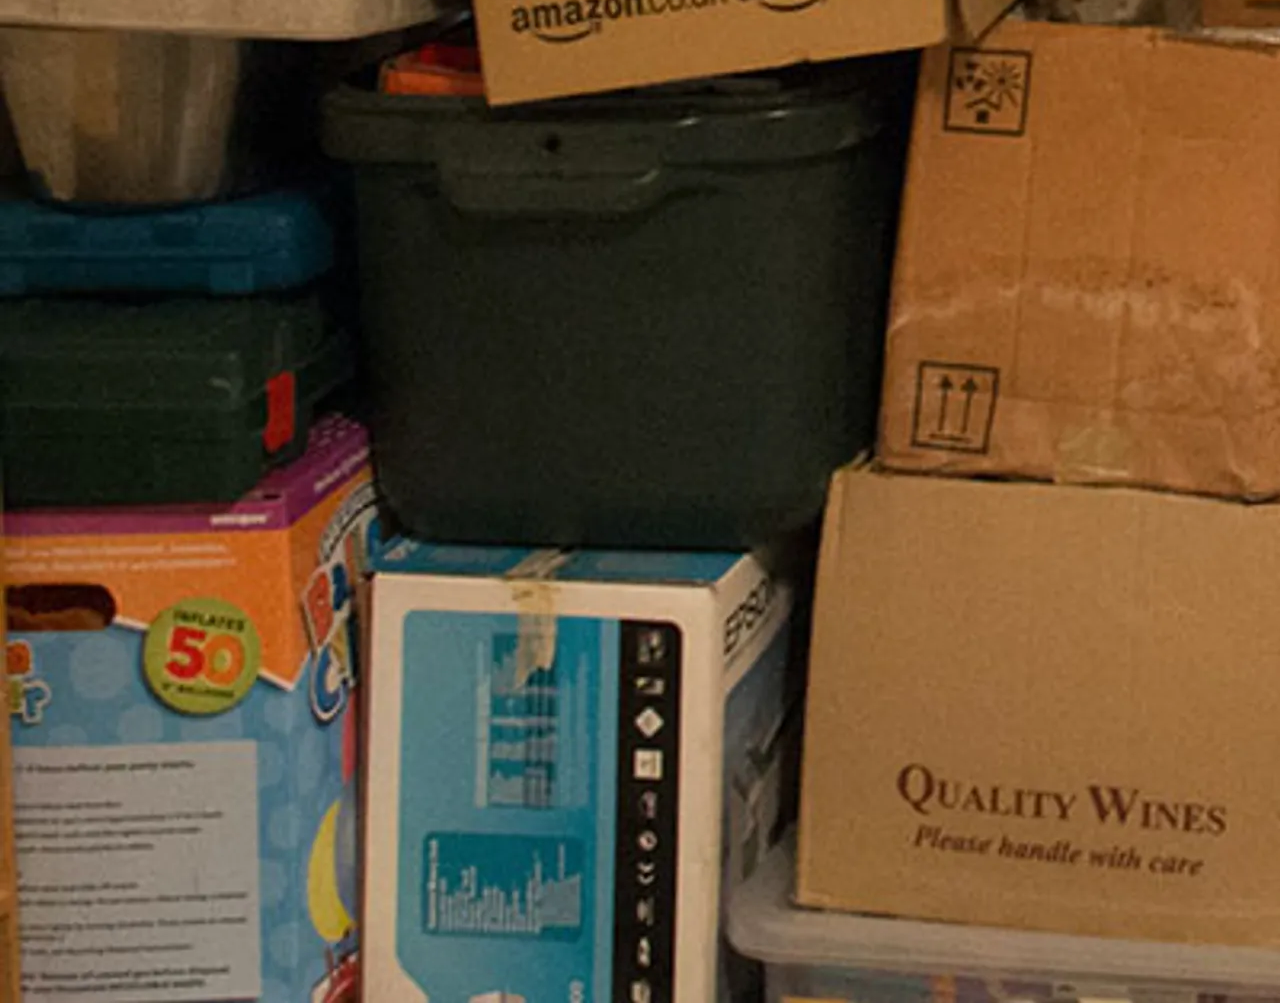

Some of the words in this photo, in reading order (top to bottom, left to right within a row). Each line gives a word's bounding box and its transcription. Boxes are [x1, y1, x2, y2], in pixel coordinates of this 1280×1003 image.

[172, 609, 246, 633] INFLATES
[164, 625, 245, 686] 50
[896, 763, 1077, 820] QUALITY
[1088, 785, 1227, 836] WINES
[914, 825, 992, 855] Please
[997, 835, 1082, 865] handle
[1088, 845, 1142, 871] with
[1149, 856, 1204, 877] care
